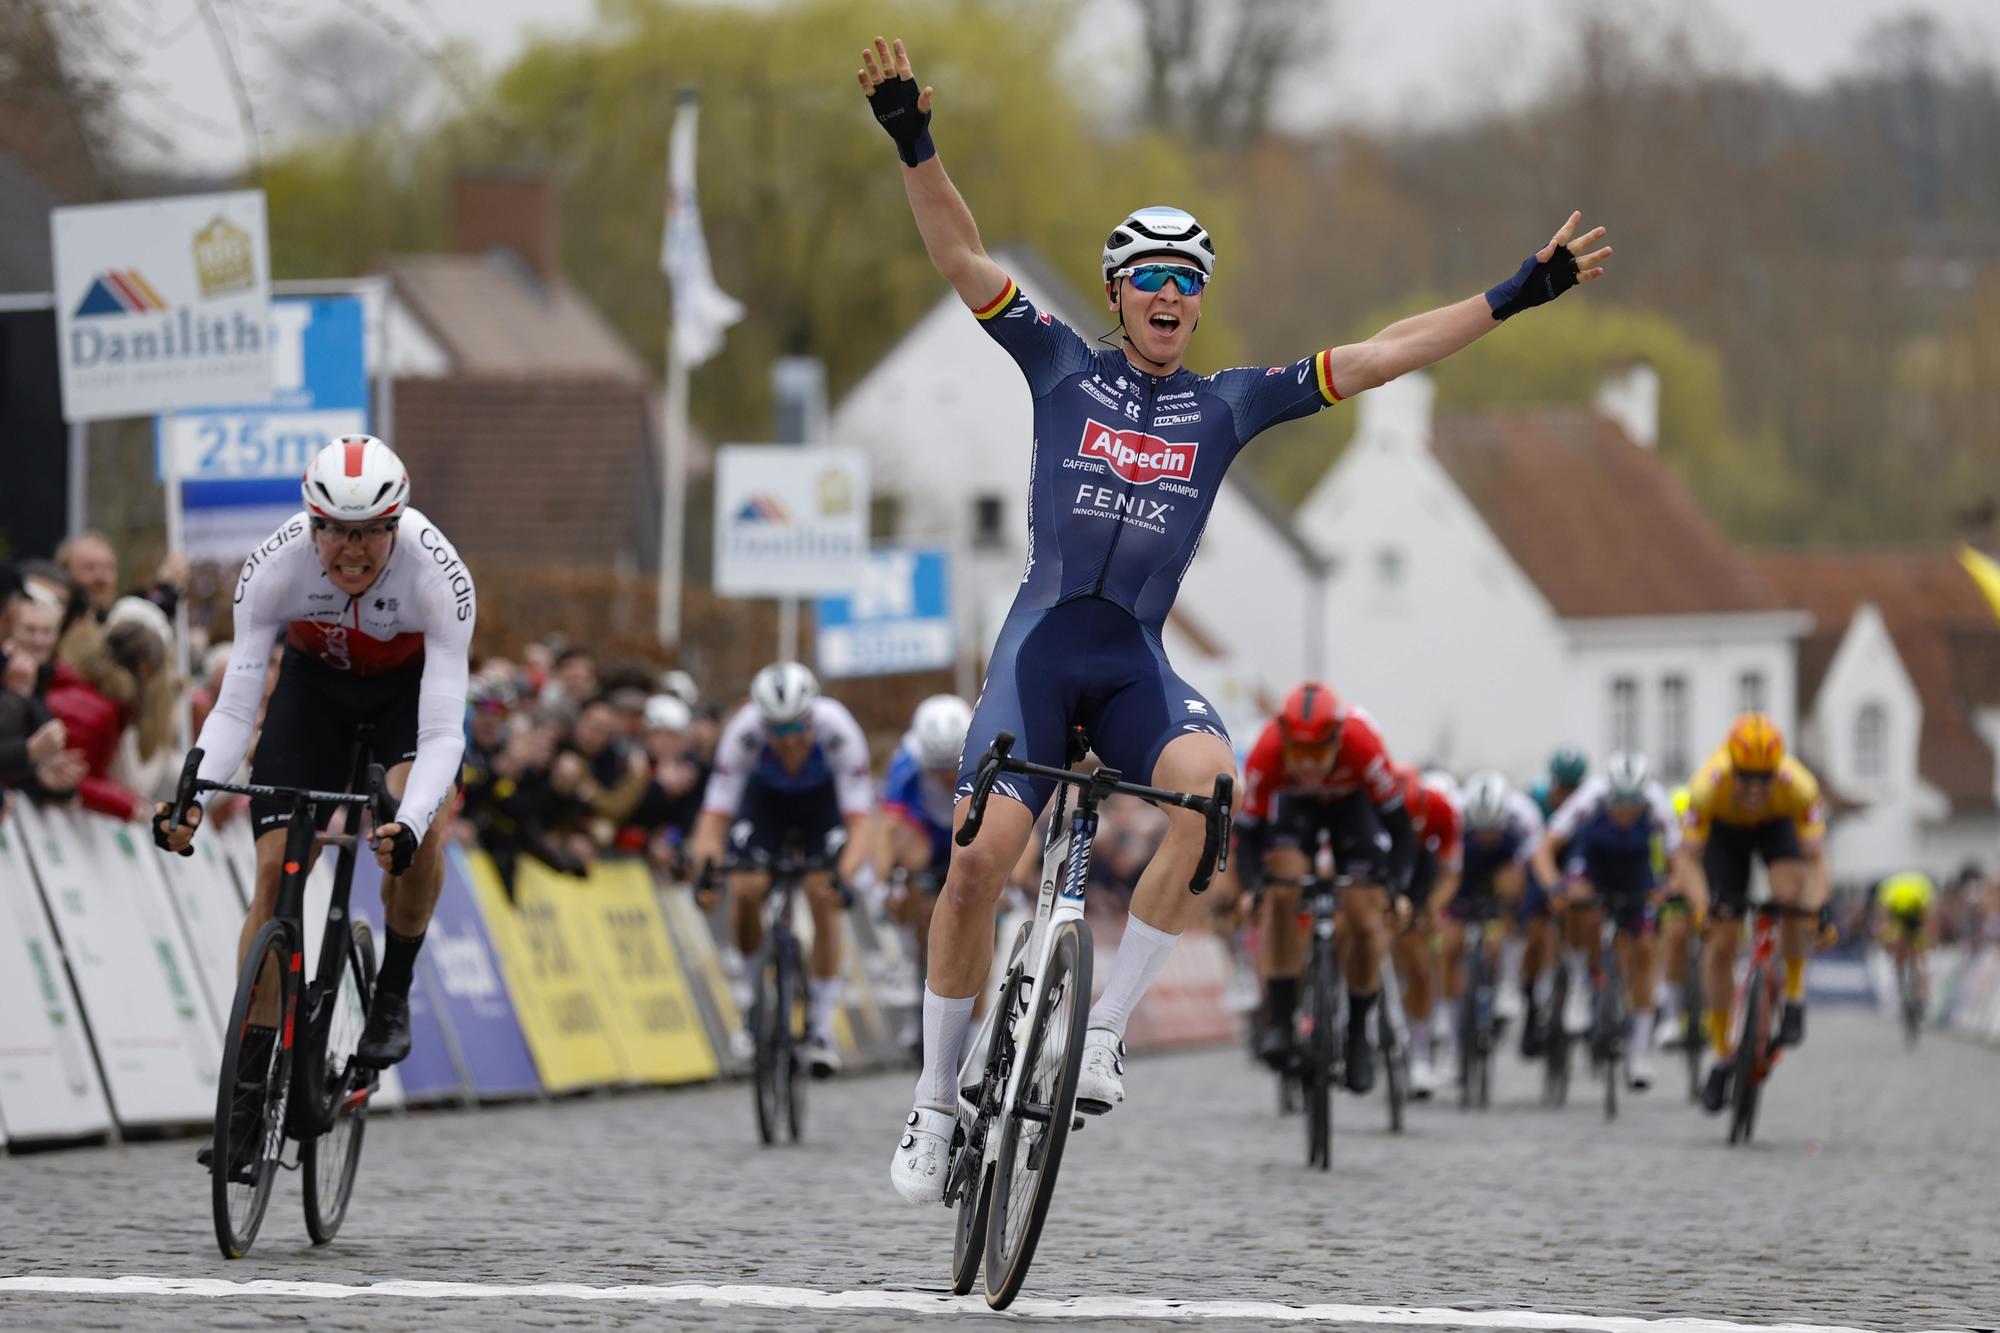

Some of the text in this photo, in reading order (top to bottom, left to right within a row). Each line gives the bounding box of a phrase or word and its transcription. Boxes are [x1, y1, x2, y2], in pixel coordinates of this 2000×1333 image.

[70, 306, 261, 368] Danilith
[1101, 382, 1123, 399] ZWIFT
[1156, 400, 1199, 412] CANYON
[198, 420, 327, 471] 25m
[1062, 458, 1106, 474] CAFFEINE
[1090, 431, 1186, 472] Alpecin
[1075, 483, 1171, 524] FENIX
[1158, 481, 1199, 499] SHAMPOO
[1122, 516, 1166, 534] MATERIALS
[233, 520, 304, 605] Cofidis
[419, 527, 473, 623] Cofidis
[1022, 525, 1036, 583] Alpecin
[1064, 833, 1082, 894] CANYON
[1076, 836, 1092, 896] CANYON
